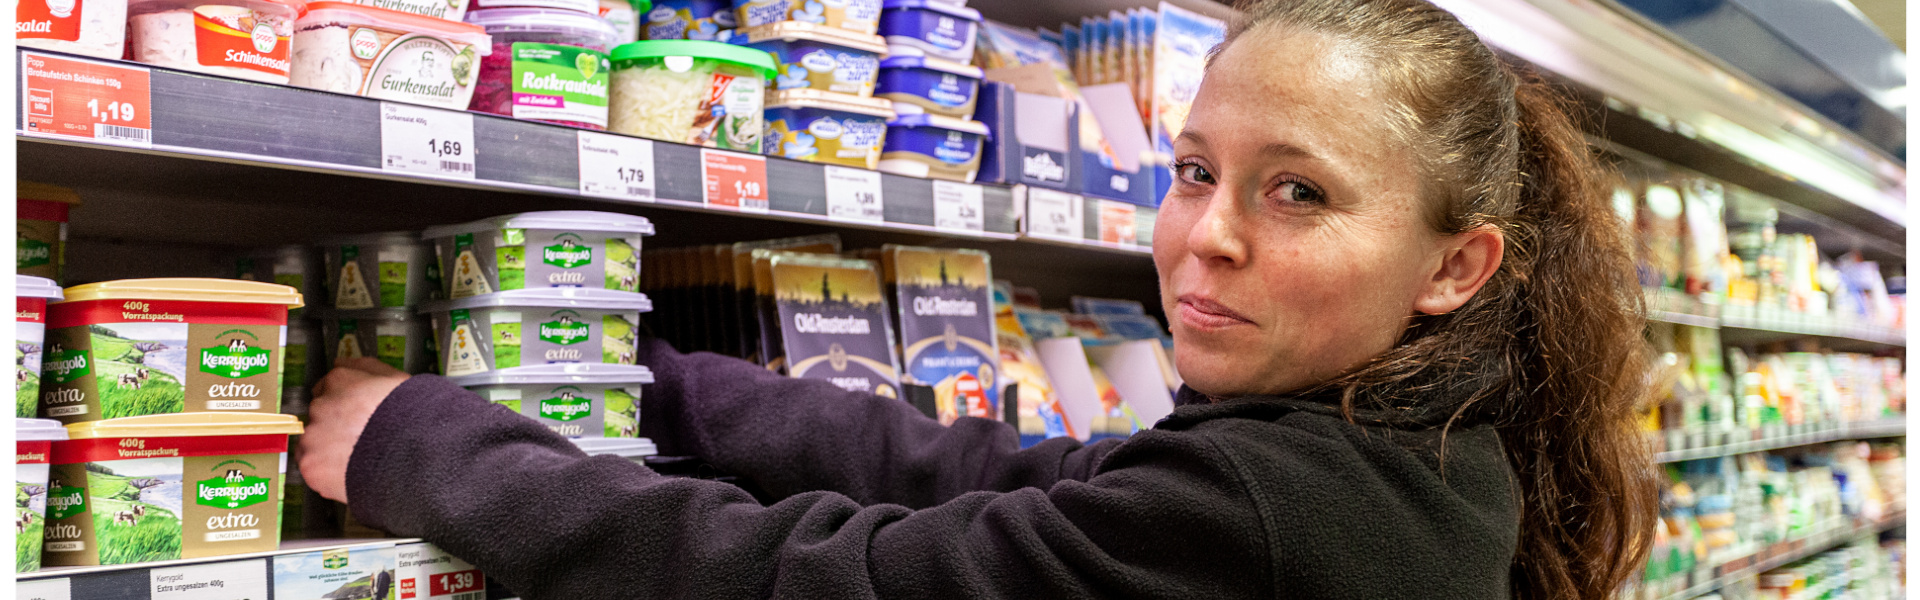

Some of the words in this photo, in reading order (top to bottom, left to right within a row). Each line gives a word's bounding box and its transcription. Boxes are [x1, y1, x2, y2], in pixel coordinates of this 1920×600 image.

[27, 57, 44, 68] Popp
[27, 67, 73, 81] Brotaufstrich
[73, 73, 105, 85] Schinken
[106, 78, 122, 89] 150g
[381, 74, 456, 98] Gurkensalat
[87, 99, 135, 122] 1,19
[429, 138, 462, 157] 1,69
[617, 167, 645, 184] 1,79
[734, 180, 760, 198] 1,19
[549, 271, 586, 283] extra
[122, 311, 184, 322] Vorratspackung
[815, 313, 871, 334] Amsterdam
[202, 351, 268, 371] Kerrygold
[545, 347, 583, 360] extra
[45, 387, 85, 405] extra
[208, 381, 260, 397] extra
[118, 447, 179, 458] Vorratspackung
[199, 482, 267, 500] Kerrygold
[206, 512, 259, 530] extra
[44, 523, 82, 539] extra
[215, 531, 252, 540] UNGESALZEN
[157, 573, 183, 582] Kerrygold
[157, 584, 173, 592] Extra
[174, 581, 208, 591] ungesalzen
[210, 580, 224, 588] 400g
[440, 572, 474, 593] 1,39
